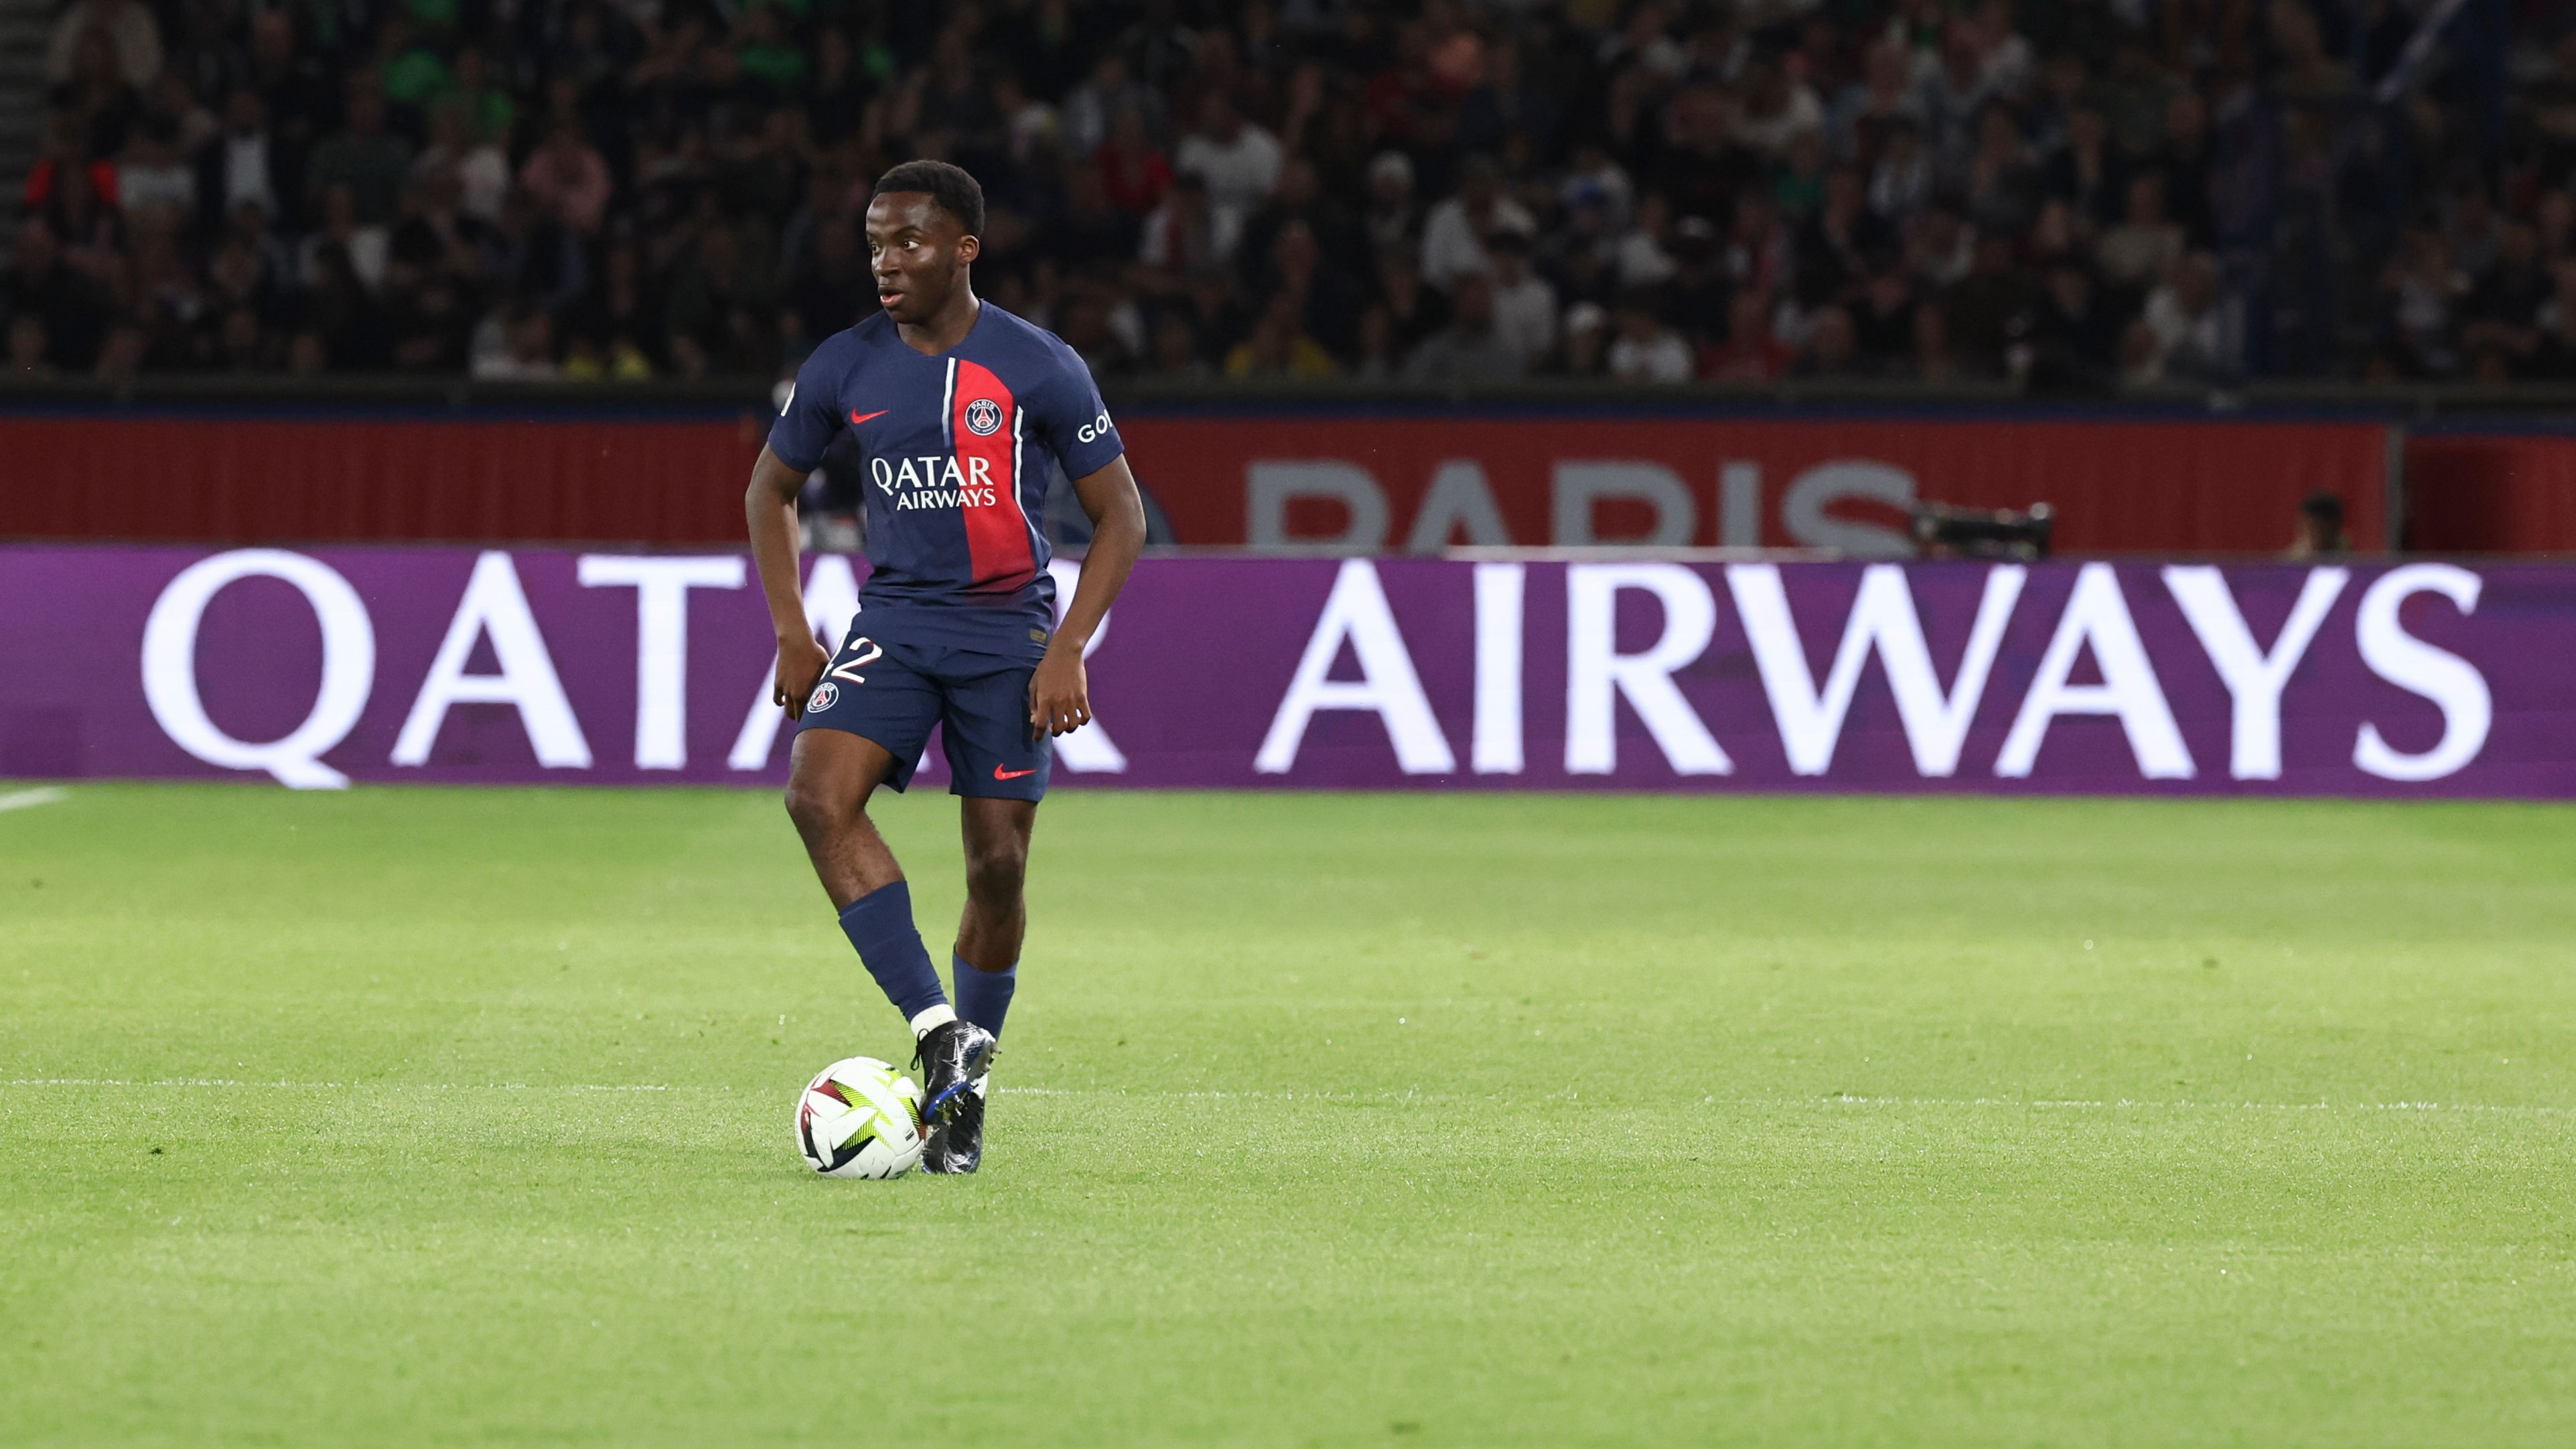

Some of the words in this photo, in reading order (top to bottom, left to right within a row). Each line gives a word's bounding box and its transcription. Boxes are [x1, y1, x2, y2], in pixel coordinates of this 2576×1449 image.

[971, 401, 995, 410] PARIS
[871, 456, 994, 496] QATAR
[897, 488, 996, 510] AIRWAYS
[140, 548, 1129, 790] QAT
[1254, 557, 2492, 782] AIRWAYS
